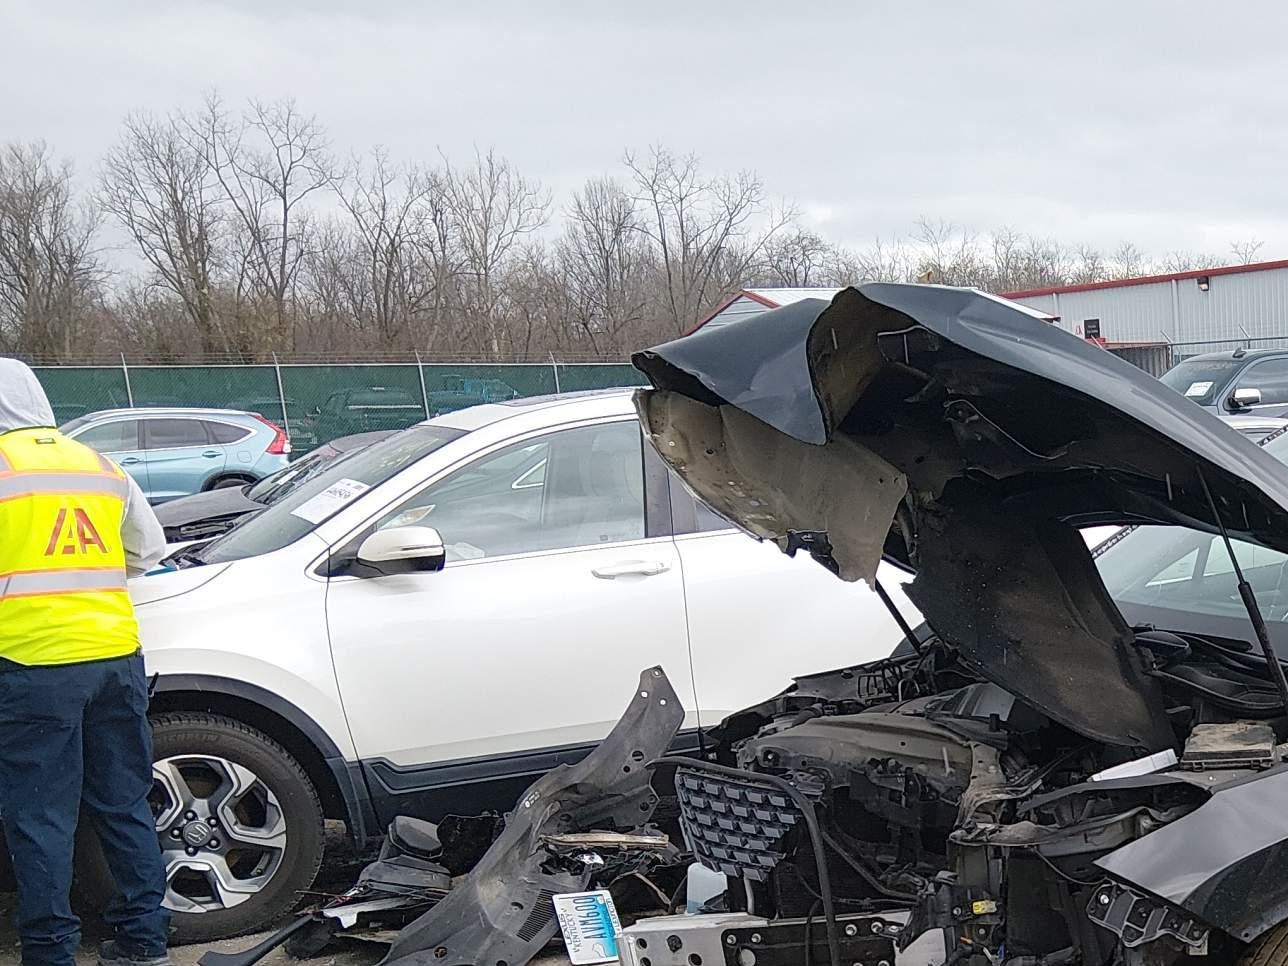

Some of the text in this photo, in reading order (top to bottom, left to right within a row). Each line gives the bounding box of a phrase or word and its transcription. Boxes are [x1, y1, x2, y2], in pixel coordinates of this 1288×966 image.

[559, 913, 573, 946] LEXUS
[566, 912, 582, 948] KENTUCKY
[573, 897, 608, 939] AVM600
